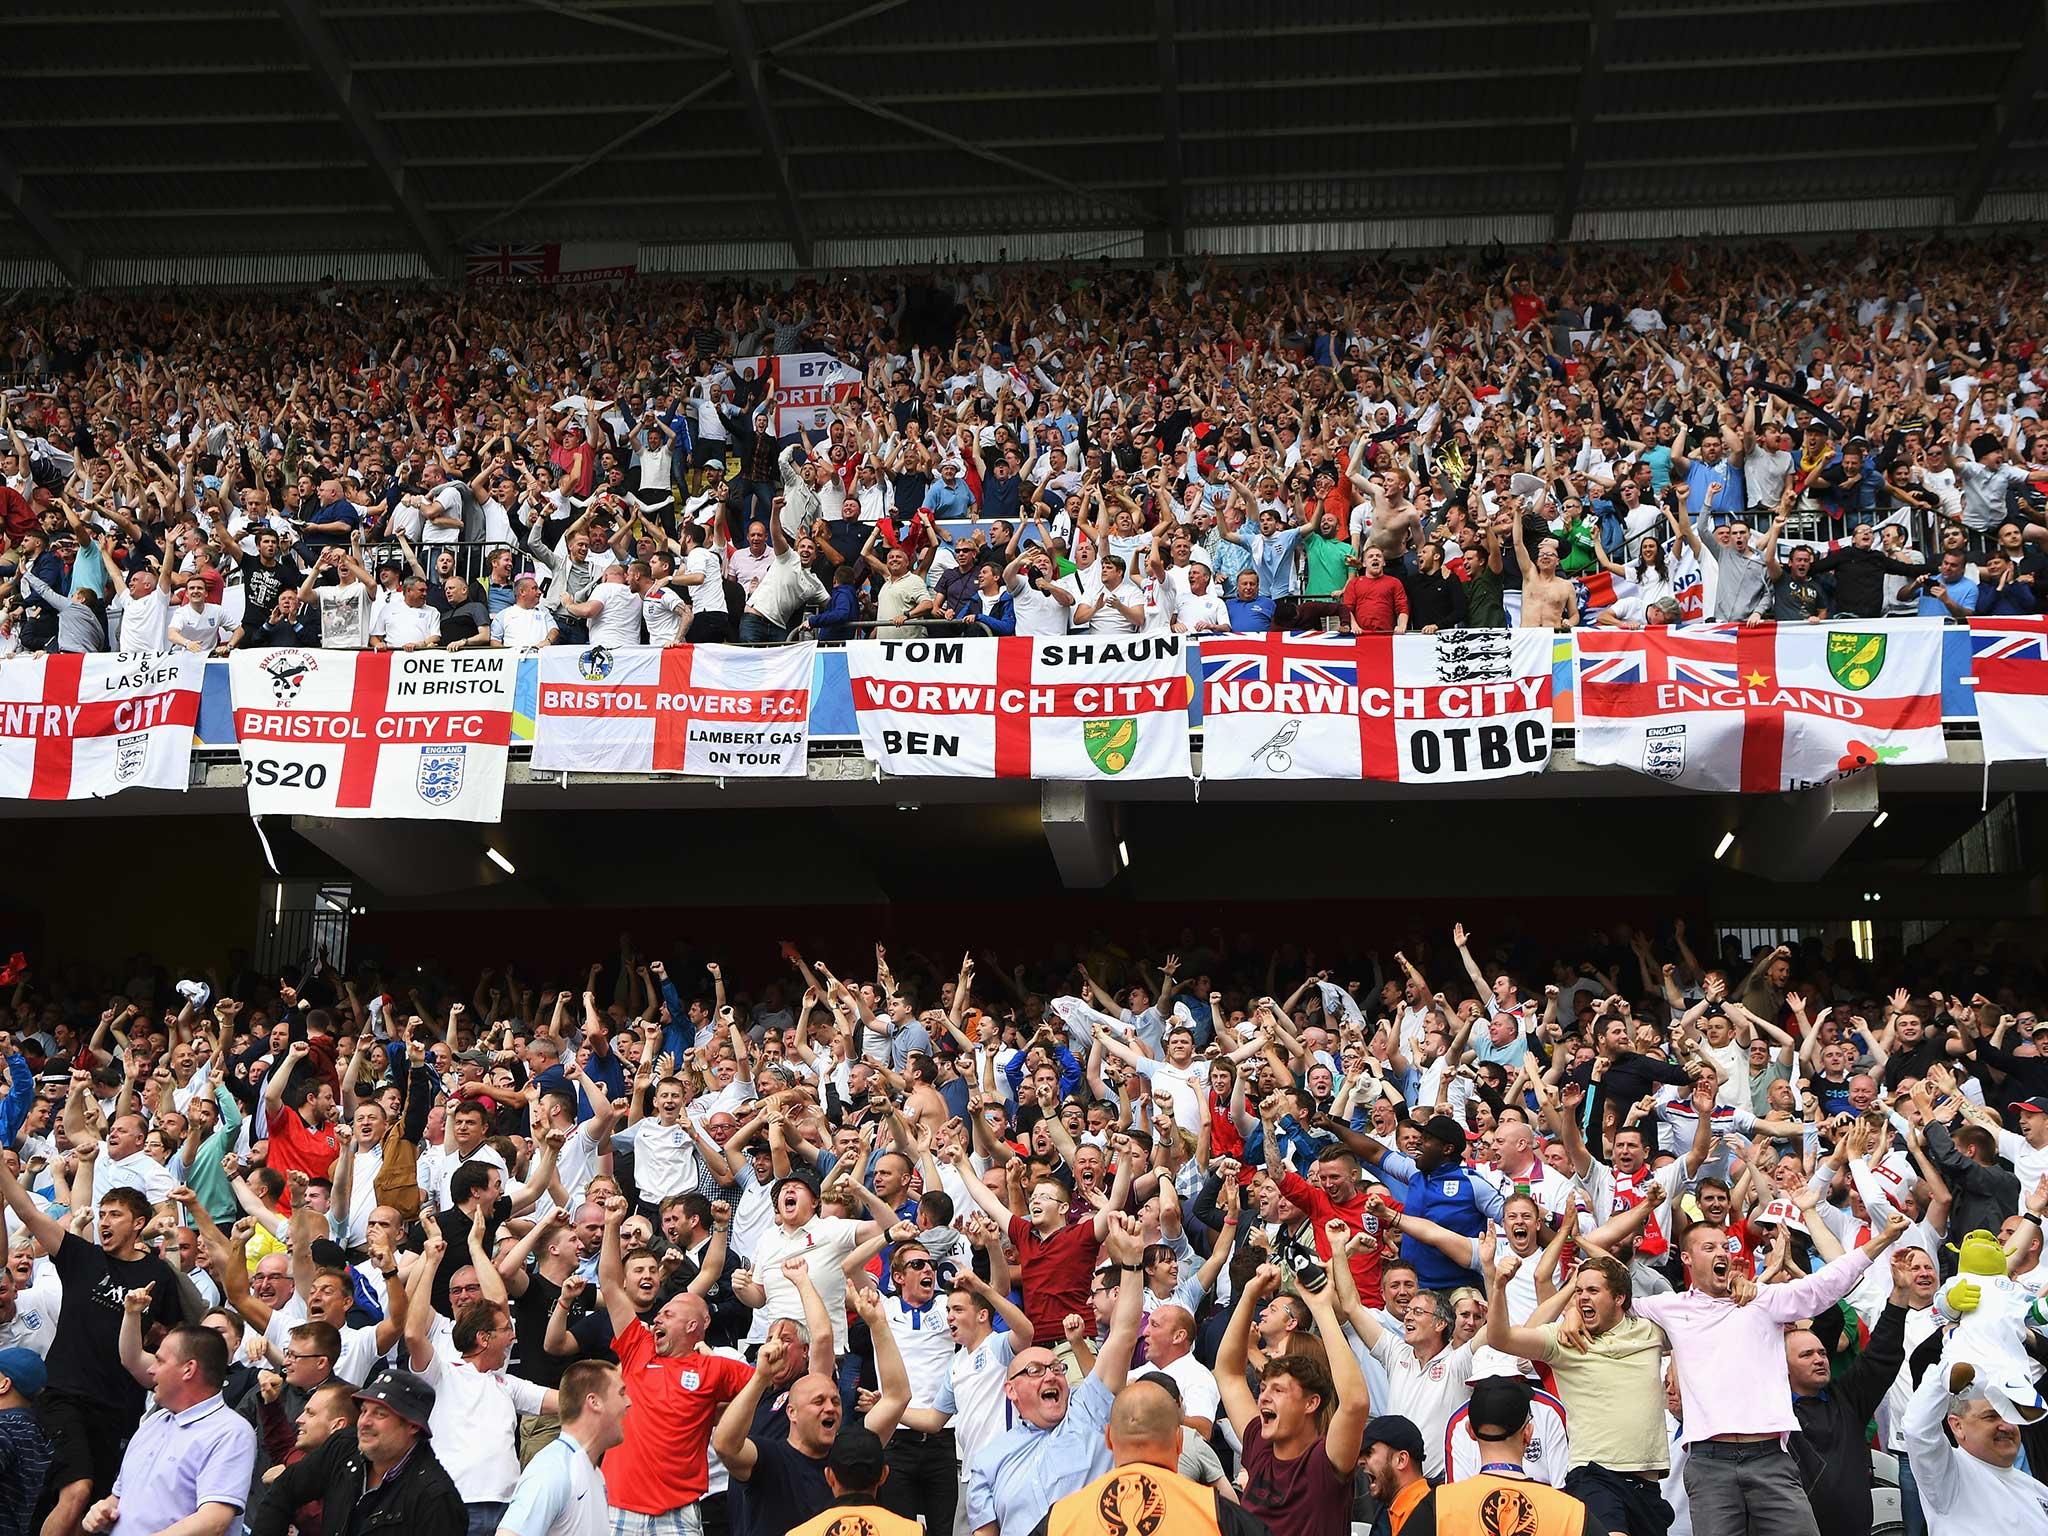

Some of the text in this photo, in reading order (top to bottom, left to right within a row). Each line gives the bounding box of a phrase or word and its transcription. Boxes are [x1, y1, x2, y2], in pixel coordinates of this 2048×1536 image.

[880, 641, 964, 664] TOM
[1041, 636, 1179, 666] SHAUN
[140, 661, 149, 672] &
[403, 658, 504, 673] ONE TEAM
[105, 667, 179, 690] LASHER
[398, 679, 505, 695] IN BRISTOL
[543, 690, 802, 715] BRISTOL ROVERS F.C.
[865, 680, 1172, 714] NORWICH CITY
[1210, 677, 1545, 718] NORWICH CITY
[1656, 684, 1864, 720] ENGLAND
[113, 692, 176, 732] CITY
[243, 713, 484, 739] BRISTOL CITY FC
[689, 730, 802, 745] LAMBERT GAS
[1648, 725, 1684, 737] ENGLAND
[118, 734, 148, 746] ENGLAND
[425, 746, 464, 754] ENGLAND
[882, 730, 959, 757] BEN
[1410, 719, 1548, 775] OTBC
[709, 751, 781, 765] ON TOUR
